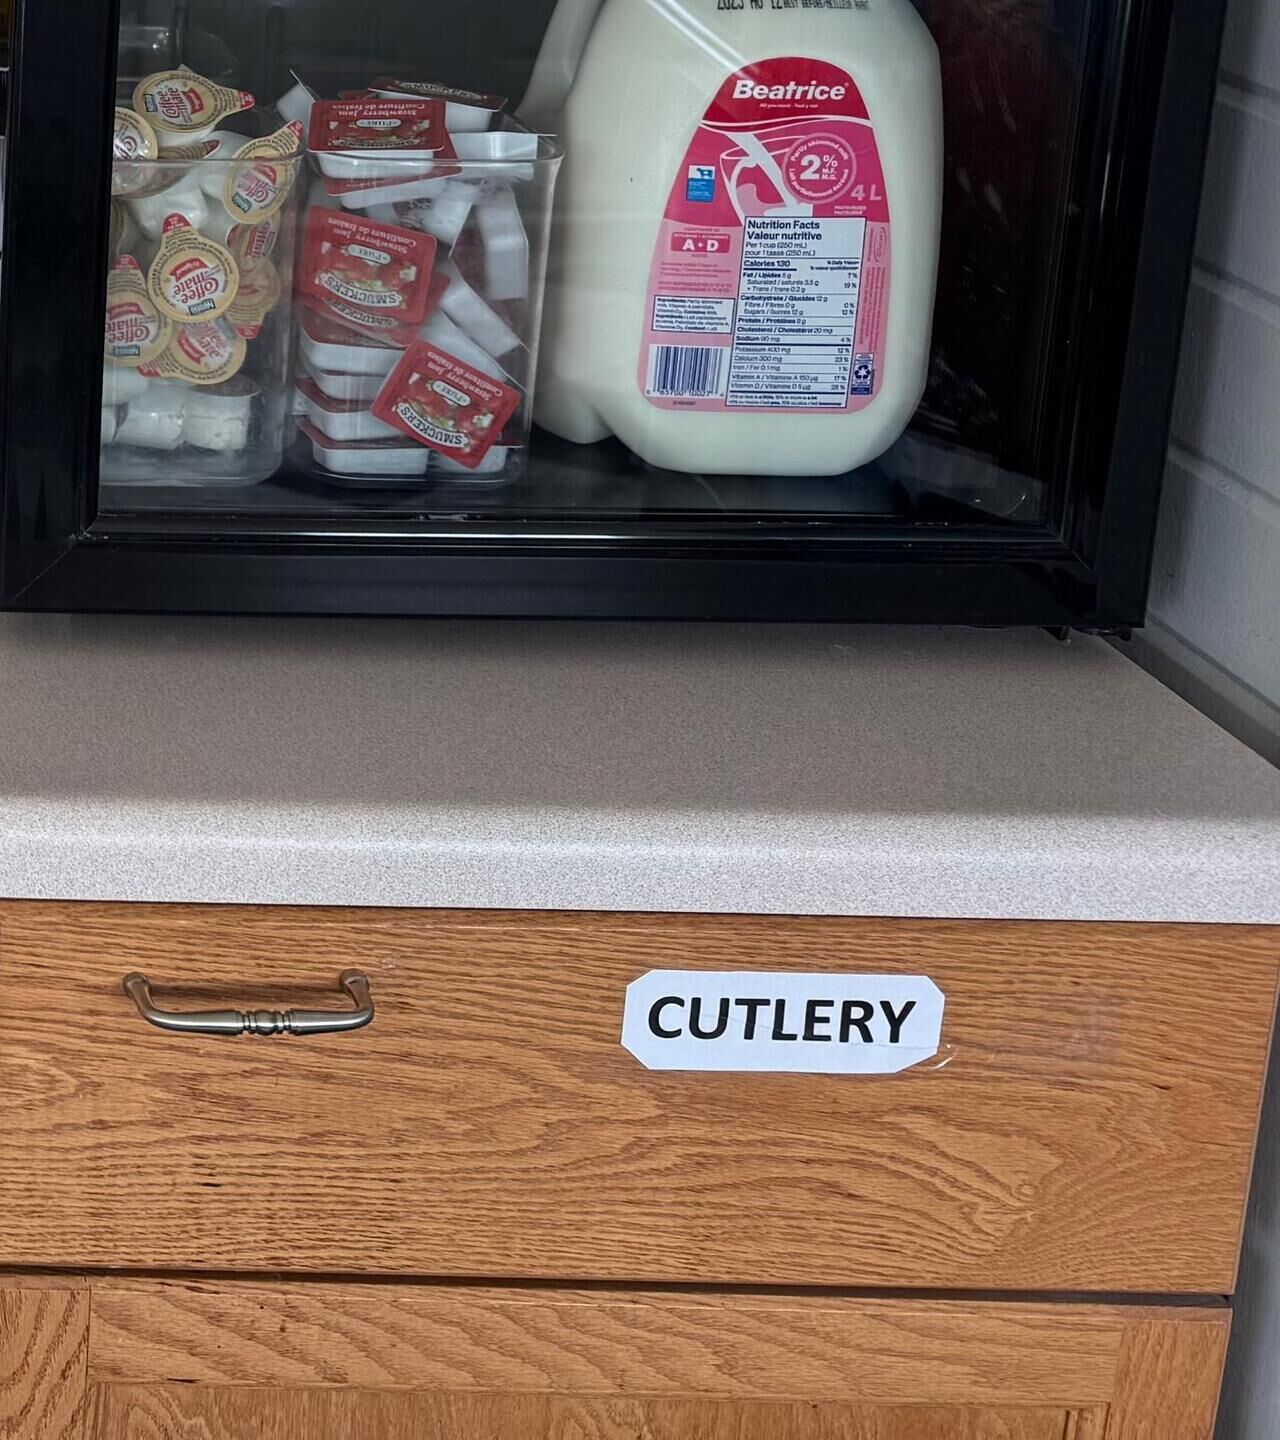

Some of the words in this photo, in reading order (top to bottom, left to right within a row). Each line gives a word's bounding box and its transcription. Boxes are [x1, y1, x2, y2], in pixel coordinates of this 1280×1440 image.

[732, 80, 846, 101] Beatrice
[850, 184, 865, 201] 4
[869, 184, 882, 201] L
[747, 220, 791, 229] Nutrition
[793, 220, 820, 229] Facts
[746, 231, 779, 240] Valeur
[781, 231, 822, 240] nutritive
[682, 239, 696, 251] A
[706, 239, 719, 252] D
[174, 271, 208, 295] mate
[180, 277, 219, 304] Coffee
[108, 325, 150, 344] Coffee
[647, 996, 917, 1044] CUTLERY
